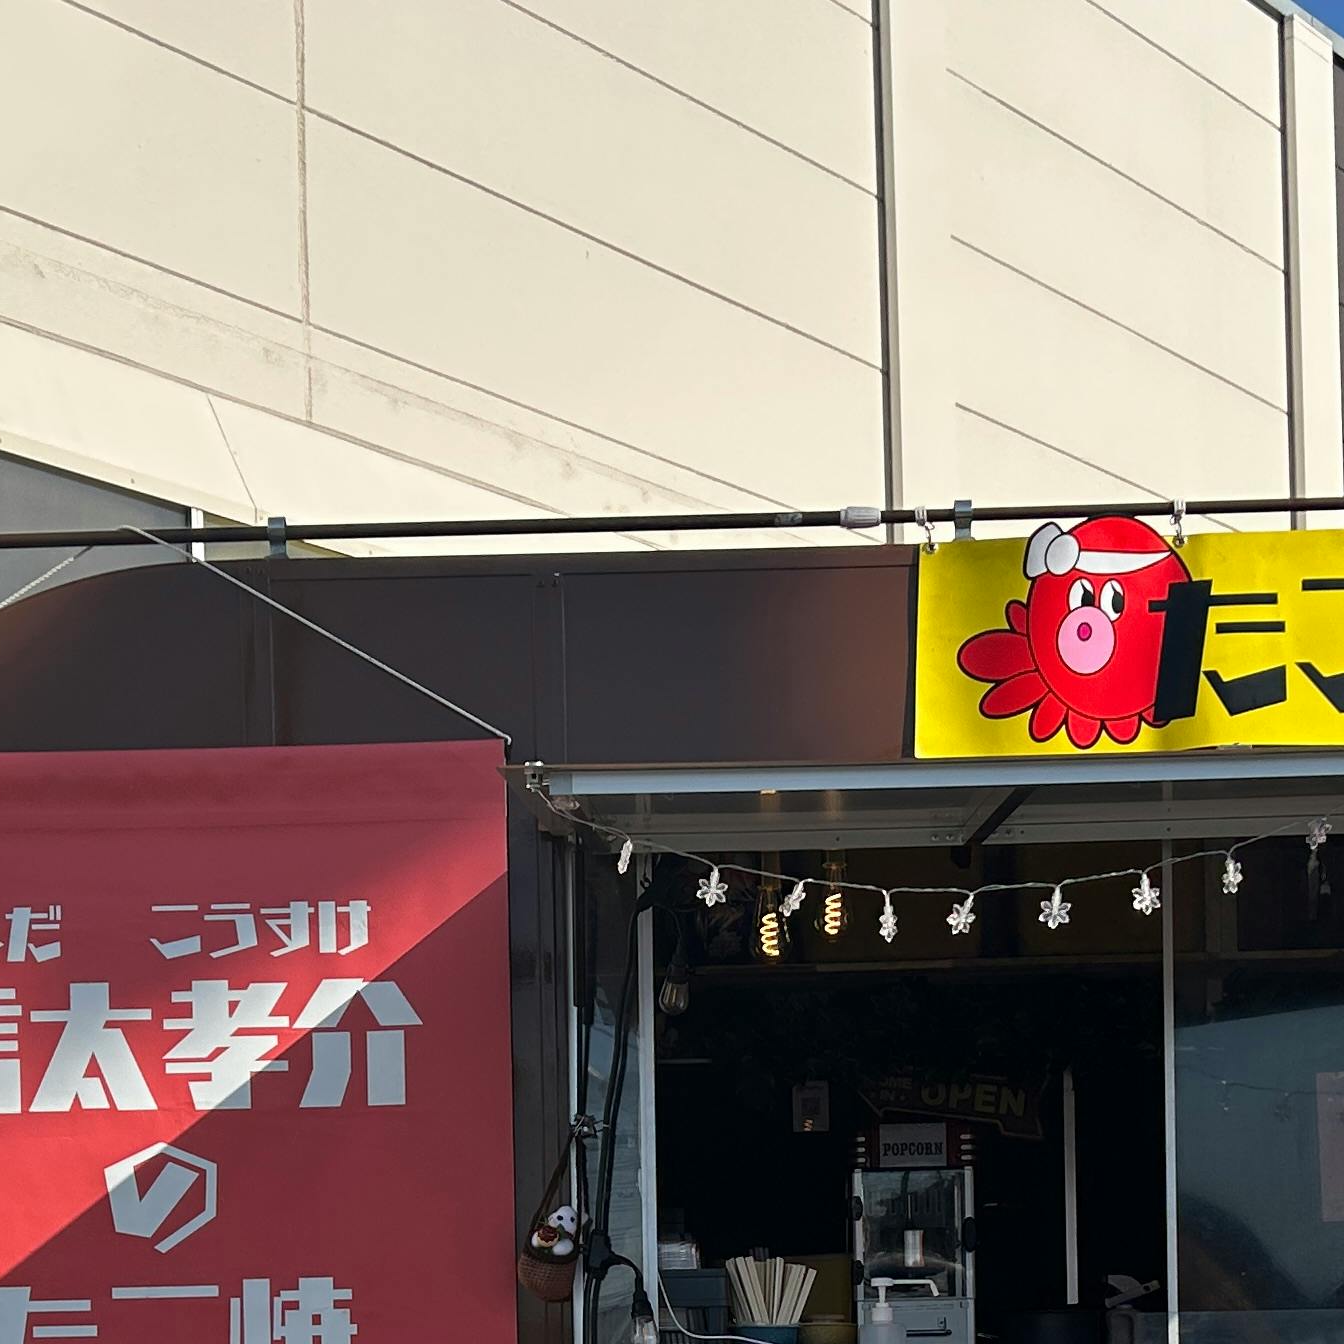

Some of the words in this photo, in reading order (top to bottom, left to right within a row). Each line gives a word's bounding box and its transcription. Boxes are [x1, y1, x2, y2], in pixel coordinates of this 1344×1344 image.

[150, 900, 372, 960] こうすけ
[882, 1142, 944, 1157] POPCORN
[104, 1142, 217, 1253] の
